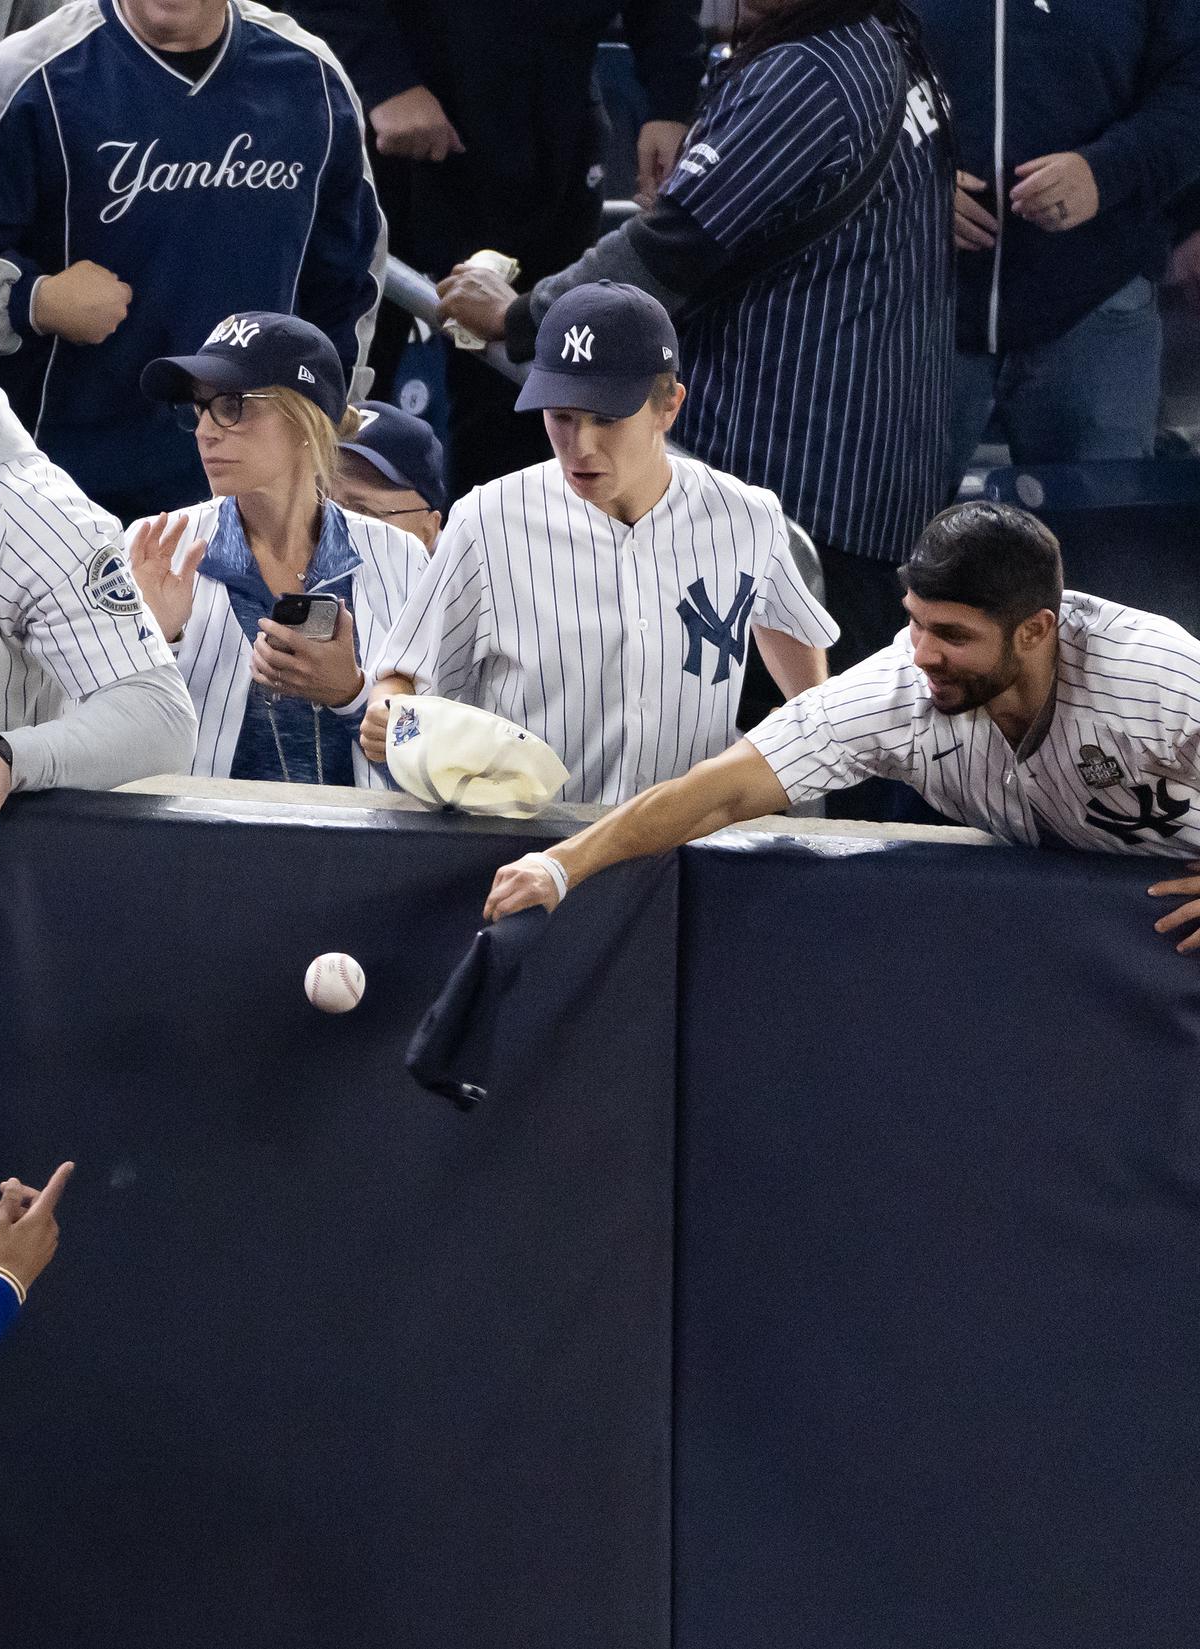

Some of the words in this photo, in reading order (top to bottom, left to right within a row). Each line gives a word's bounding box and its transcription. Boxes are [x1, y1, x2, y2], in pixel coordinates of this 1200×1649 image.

[97, 133, 304, 224] Yankees
[221, 319, 260, 348] NY
[561, 325, 595, 362] NY
[676, 571, 757, 685] NY
[1085, 776, 1190, 846] NY
